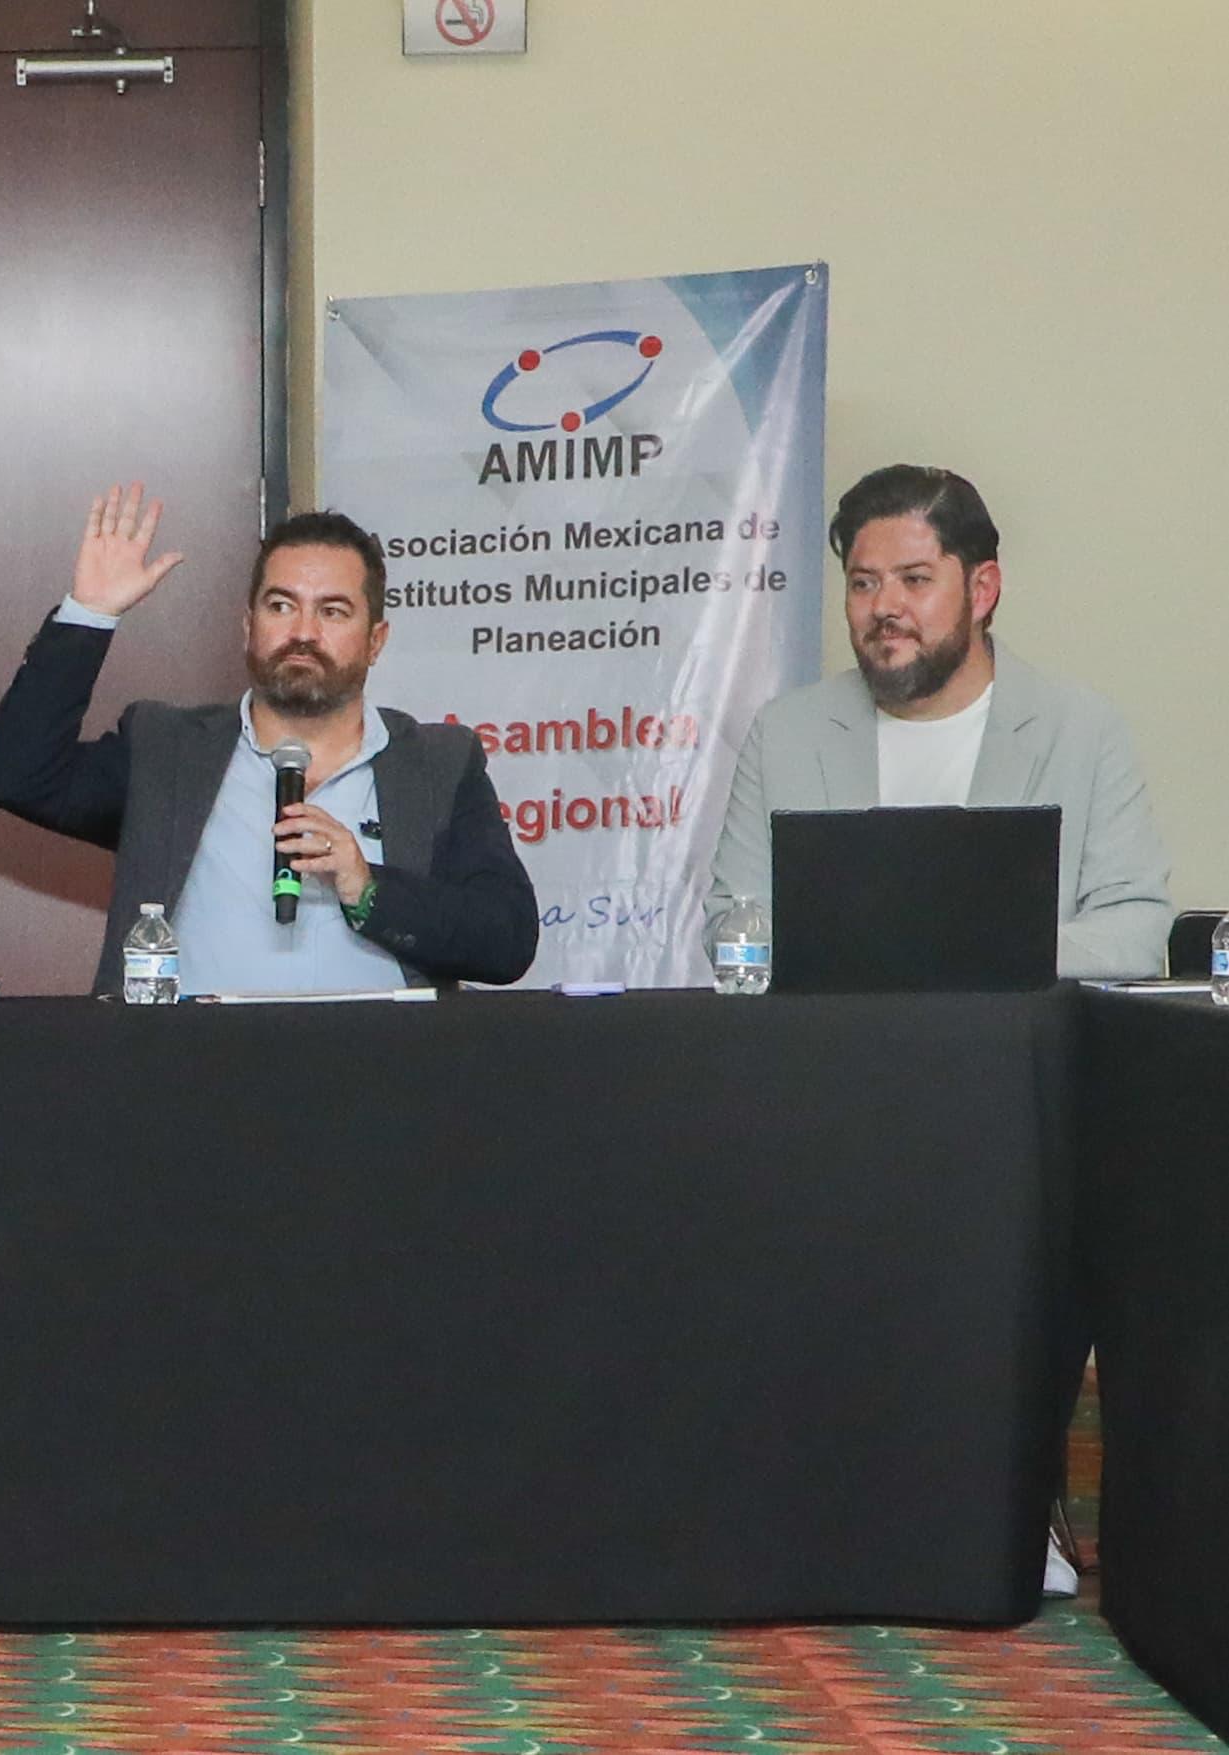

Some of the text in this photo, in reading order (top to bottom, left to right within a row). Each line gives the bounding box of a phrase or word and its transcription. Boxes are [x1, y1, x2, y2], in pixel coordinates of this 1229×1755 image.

[478, 434, 663, 485] AMIMP
[564, 519, 724, 550] Mexicana
[738, 512, 780, 540] de
[385, 564, 787, 608] stitutos Municipales de
[472, 620, 660, 654] Planeación
[445, 706, 698, 755] samblea
[500, 785, 681, 843] gional
